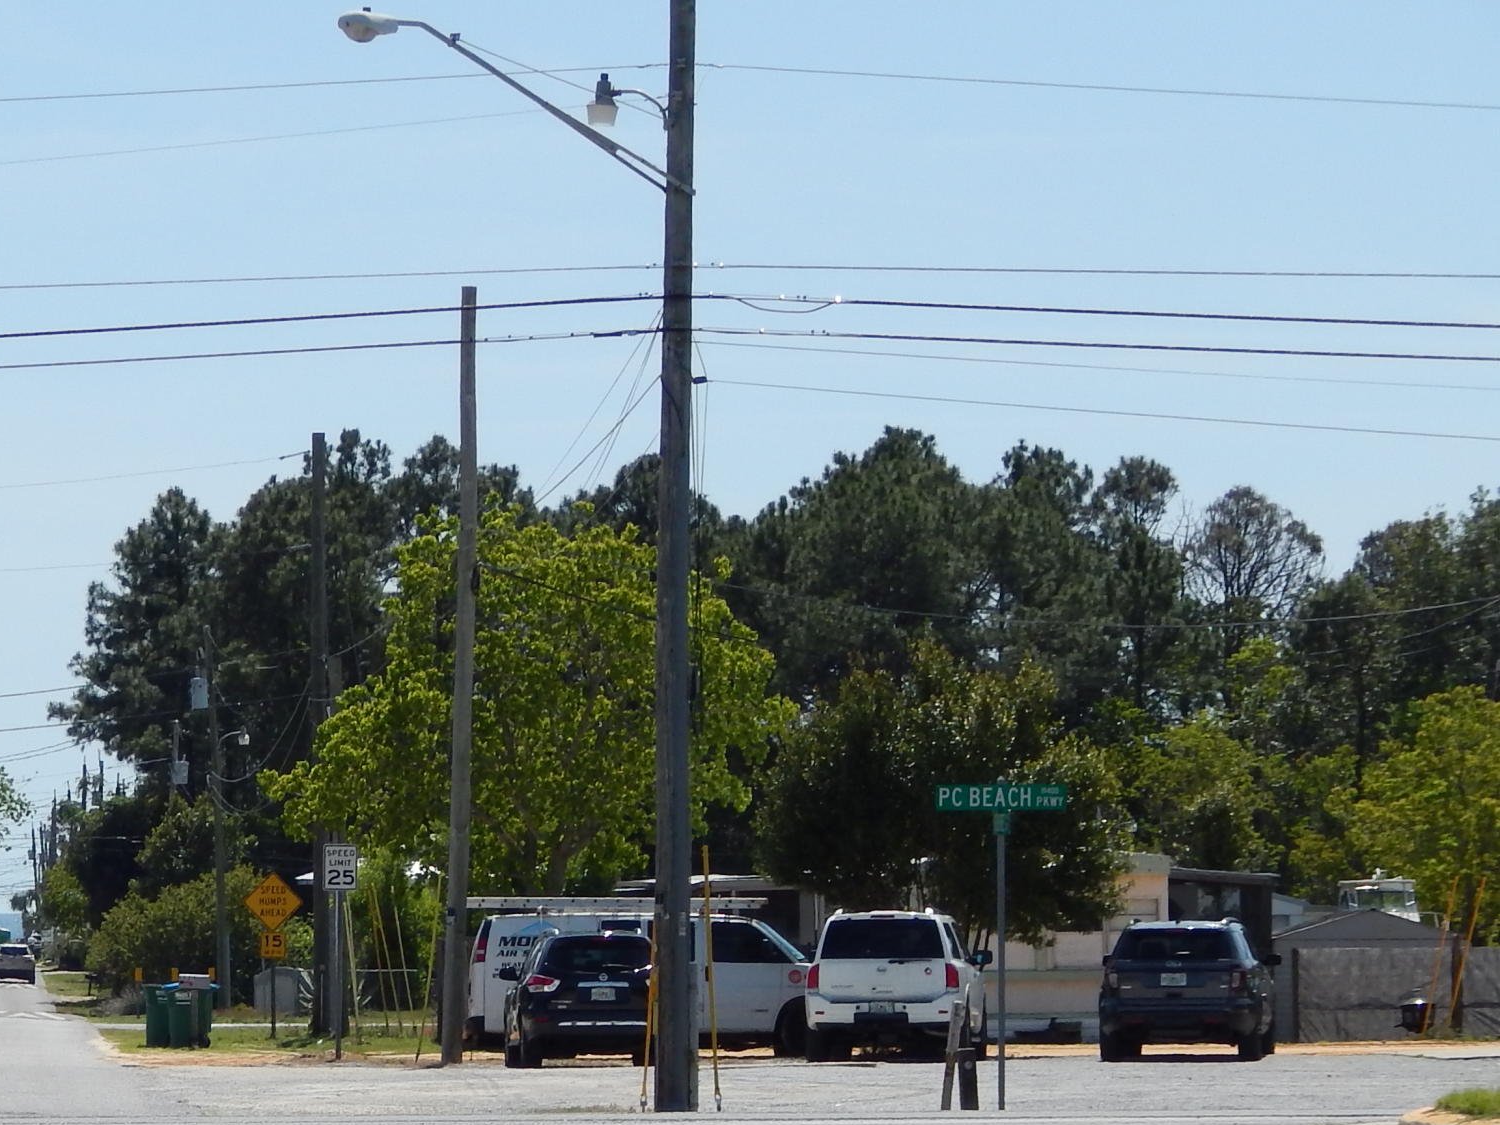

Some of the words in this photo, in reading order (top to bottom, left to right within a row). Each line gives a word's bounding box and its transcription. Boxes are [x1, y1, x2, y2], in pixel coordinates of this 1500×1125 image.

[938, 786, 963, 808] PC
[969, 786, 1032, 808] BEACH
[1036, 796, 1064, 807] PKWY
[326, 849, 356, 857] SPEED
[328, 859, 352, 867] LIMIT
[327, 869, 355, 886] 25
[260, 885, 286, 895] SPEED
[259, 896, 288, 906] HUMPS
[259, 907, 287, 917] AHEAD
[265, 934, 283, 948] 15
